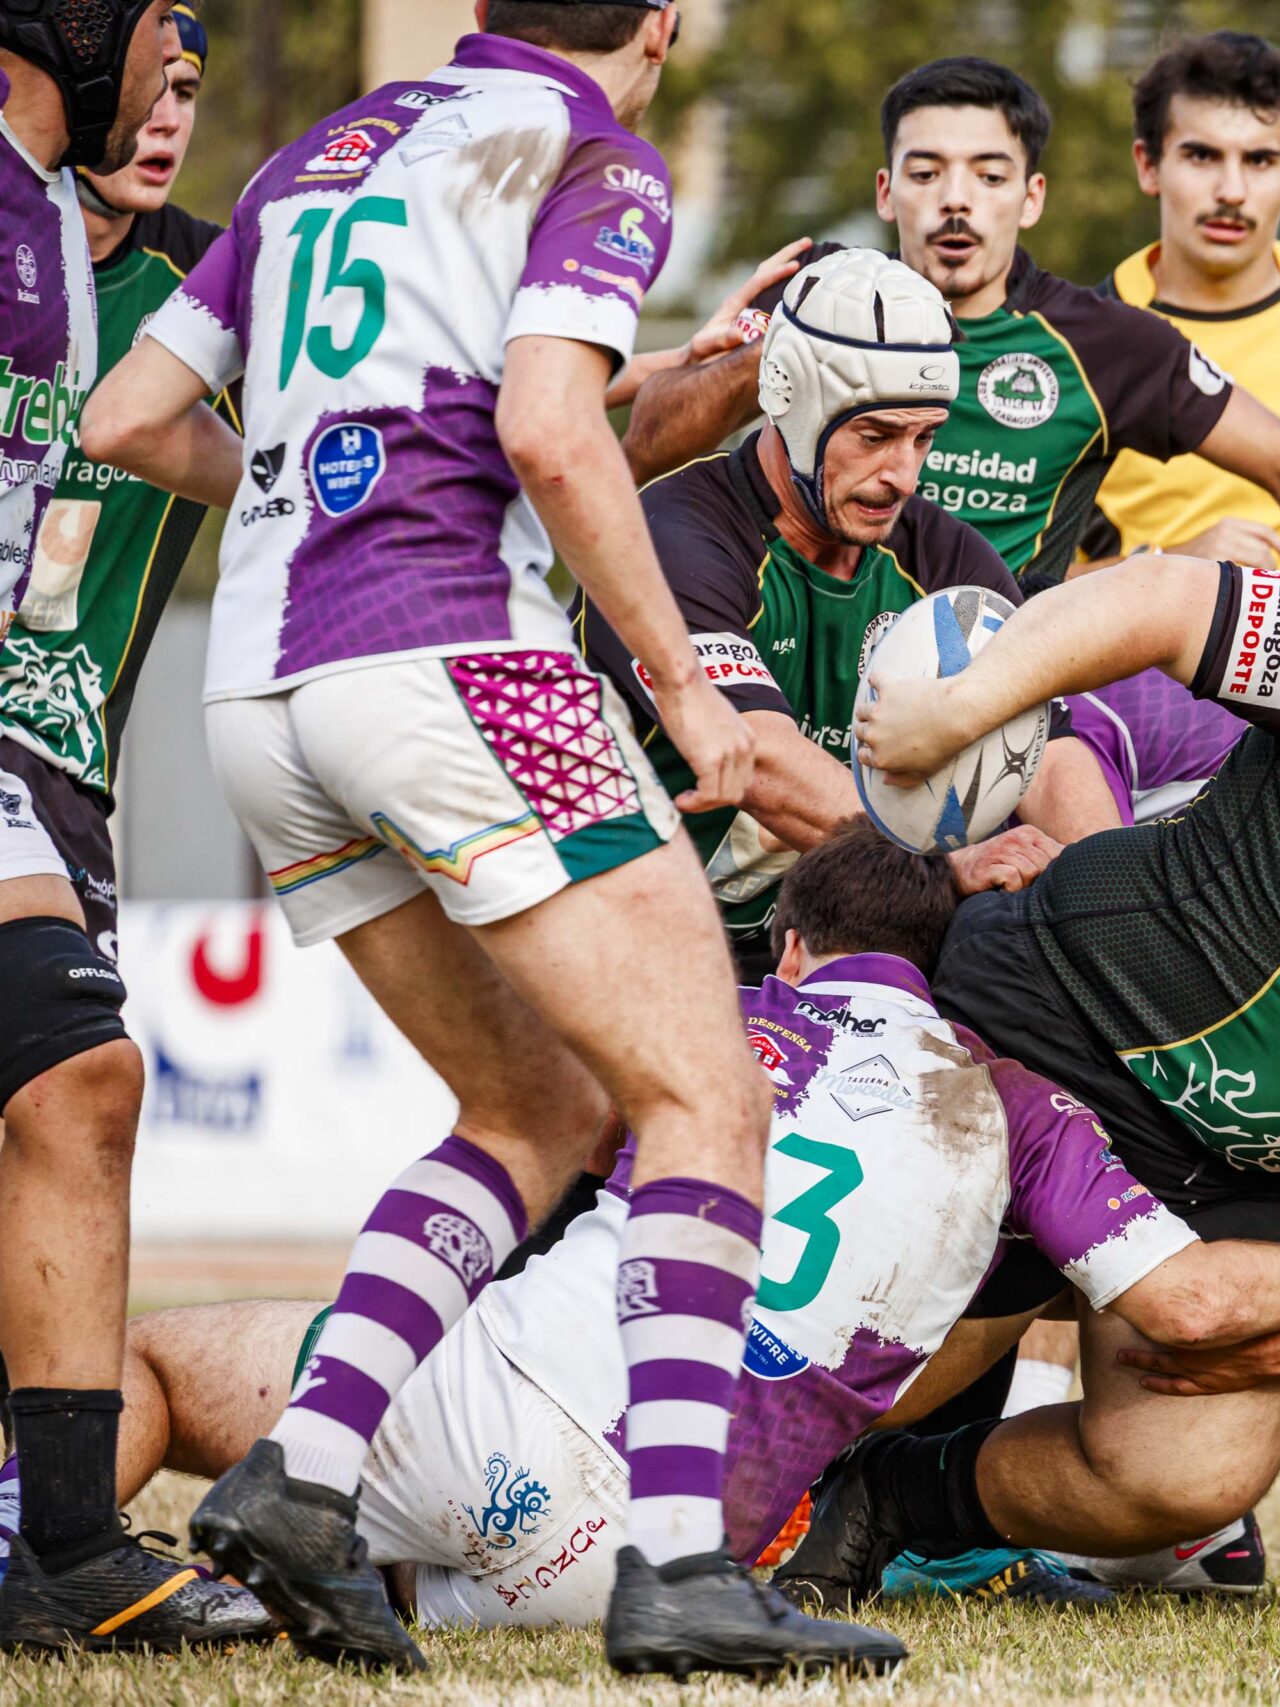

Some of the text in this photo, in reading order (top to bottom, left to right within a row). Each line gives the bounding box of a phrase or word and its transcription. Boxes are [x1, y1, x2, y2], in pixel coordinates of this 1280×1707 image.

[279, 196, 407, 391] 15
[926, 449, 1038, 484] ersidad
[921, 480, 1029, 513] agoza
[1229, 583, 1275, 695] DEPORTE
[747, 1016, 813, 1053] DESPENSA
[816, 1069, 915, 1110] Mercedes
[847, 1076, 890, 1088] TABERNA
[755, 1132, 864, 1312] 3
[748, 1320, 790, 1366] WIFRE
